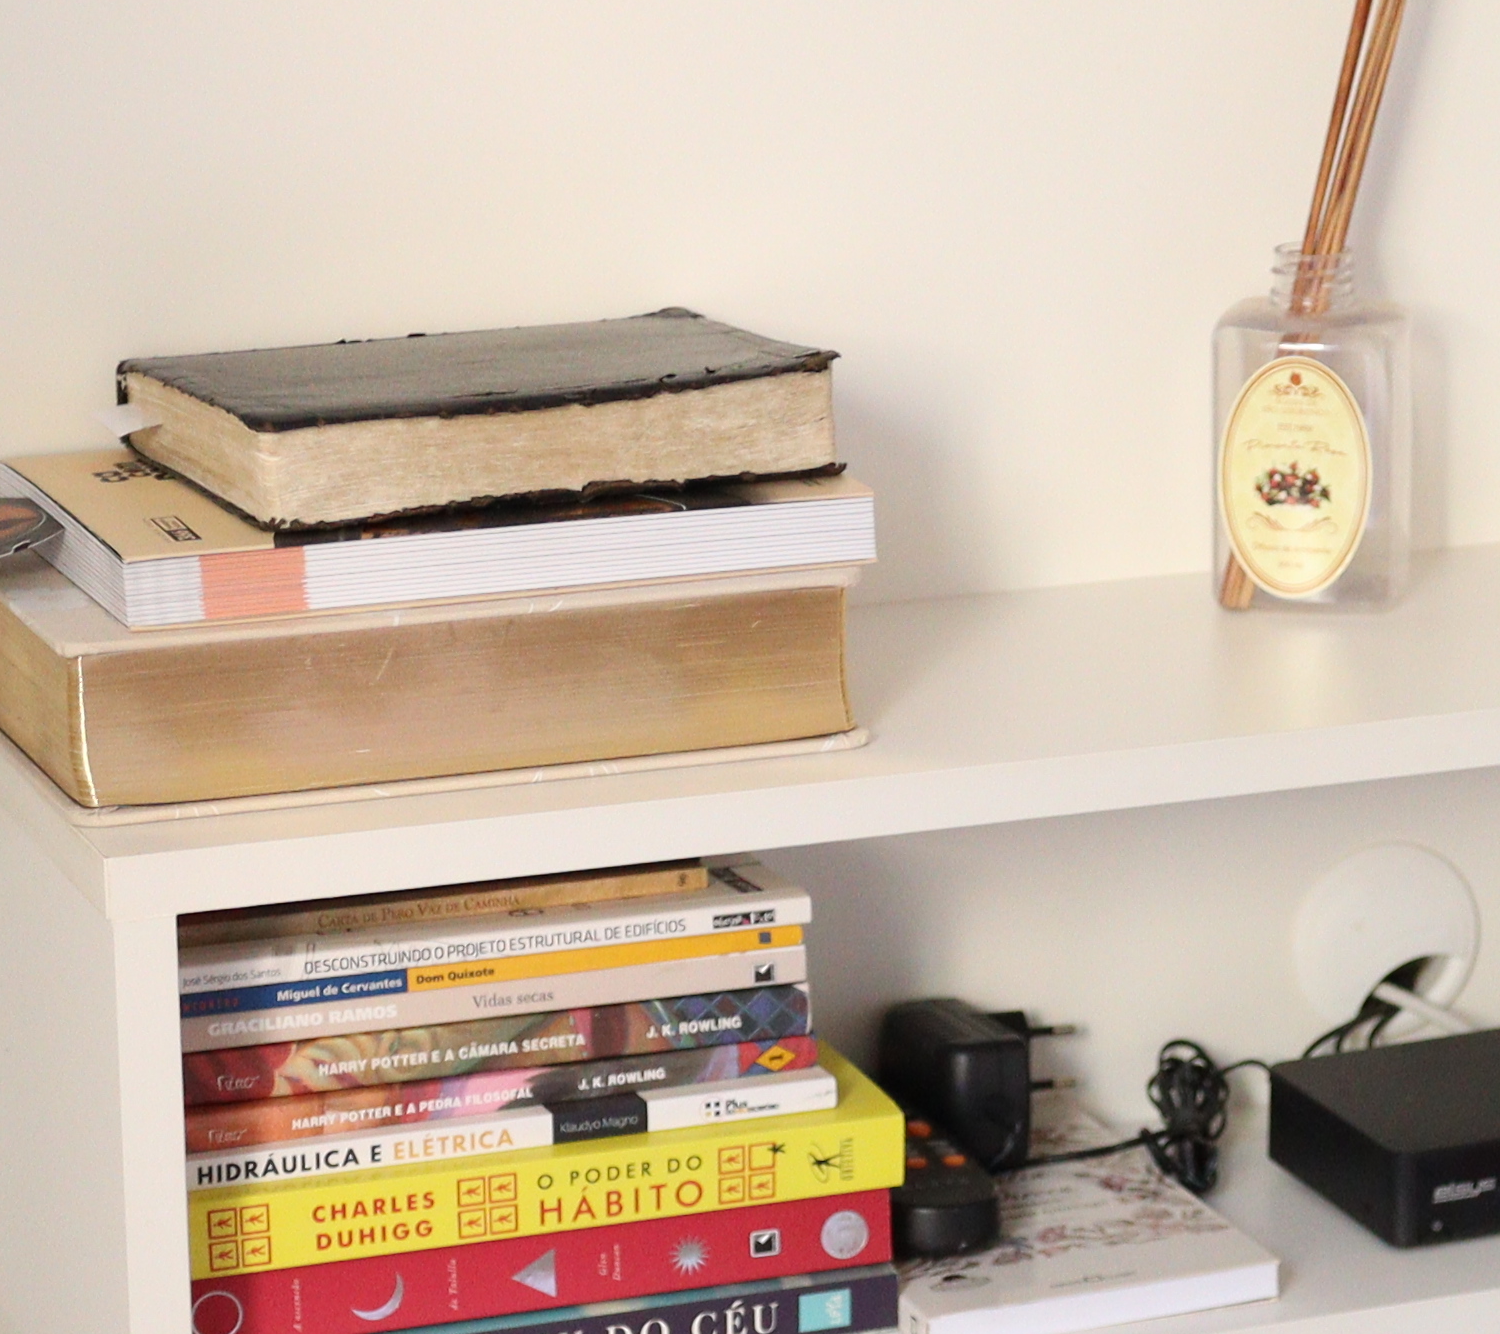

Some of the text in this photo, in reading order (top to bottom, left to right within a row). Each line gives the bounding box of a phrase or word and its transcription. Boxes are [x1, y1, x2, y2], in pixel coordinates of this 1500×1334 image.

[304, 918, 687, 975] DESCONSTRUINDO O PROJETO ESTRUTURAL DE EDIFÍCIOS
[232, 970, 248, 981] dos
[250, 967, 281, 979] Santos
[416, 967, 495, 985] Dom Quixote
[276, 977, 403, 1003] Miguel de Cervantes
[473, 991, 554, 1009] Vidas secas
[208, 1004, 397, 1036] GRACILIANO RAMOS
[646, 1016, 743, 1039] J. K. ROWLING
[318, 1033, 585, 1077] HARRY POTTER E A CÂMARA SECRETA
[577, 1068, 666, 1092] J. K. ROWLING
[291, 1087, 533, 1131] HARRY POTTER E A PEDRA FILOSOFAL
[559, 1113, 638, 1135] Klaudyo Magno
[197, 1130, 513, 1185] HIDRÁULICA E ELÉTRICA
[537, 1154, 702, 1191] O PODER DO
[311, 1192, 435, 1224] CHARLES
[539, 1179, 703, 1227] HÁBITO
[316, 1220, 434, 1251] DUHIGG
